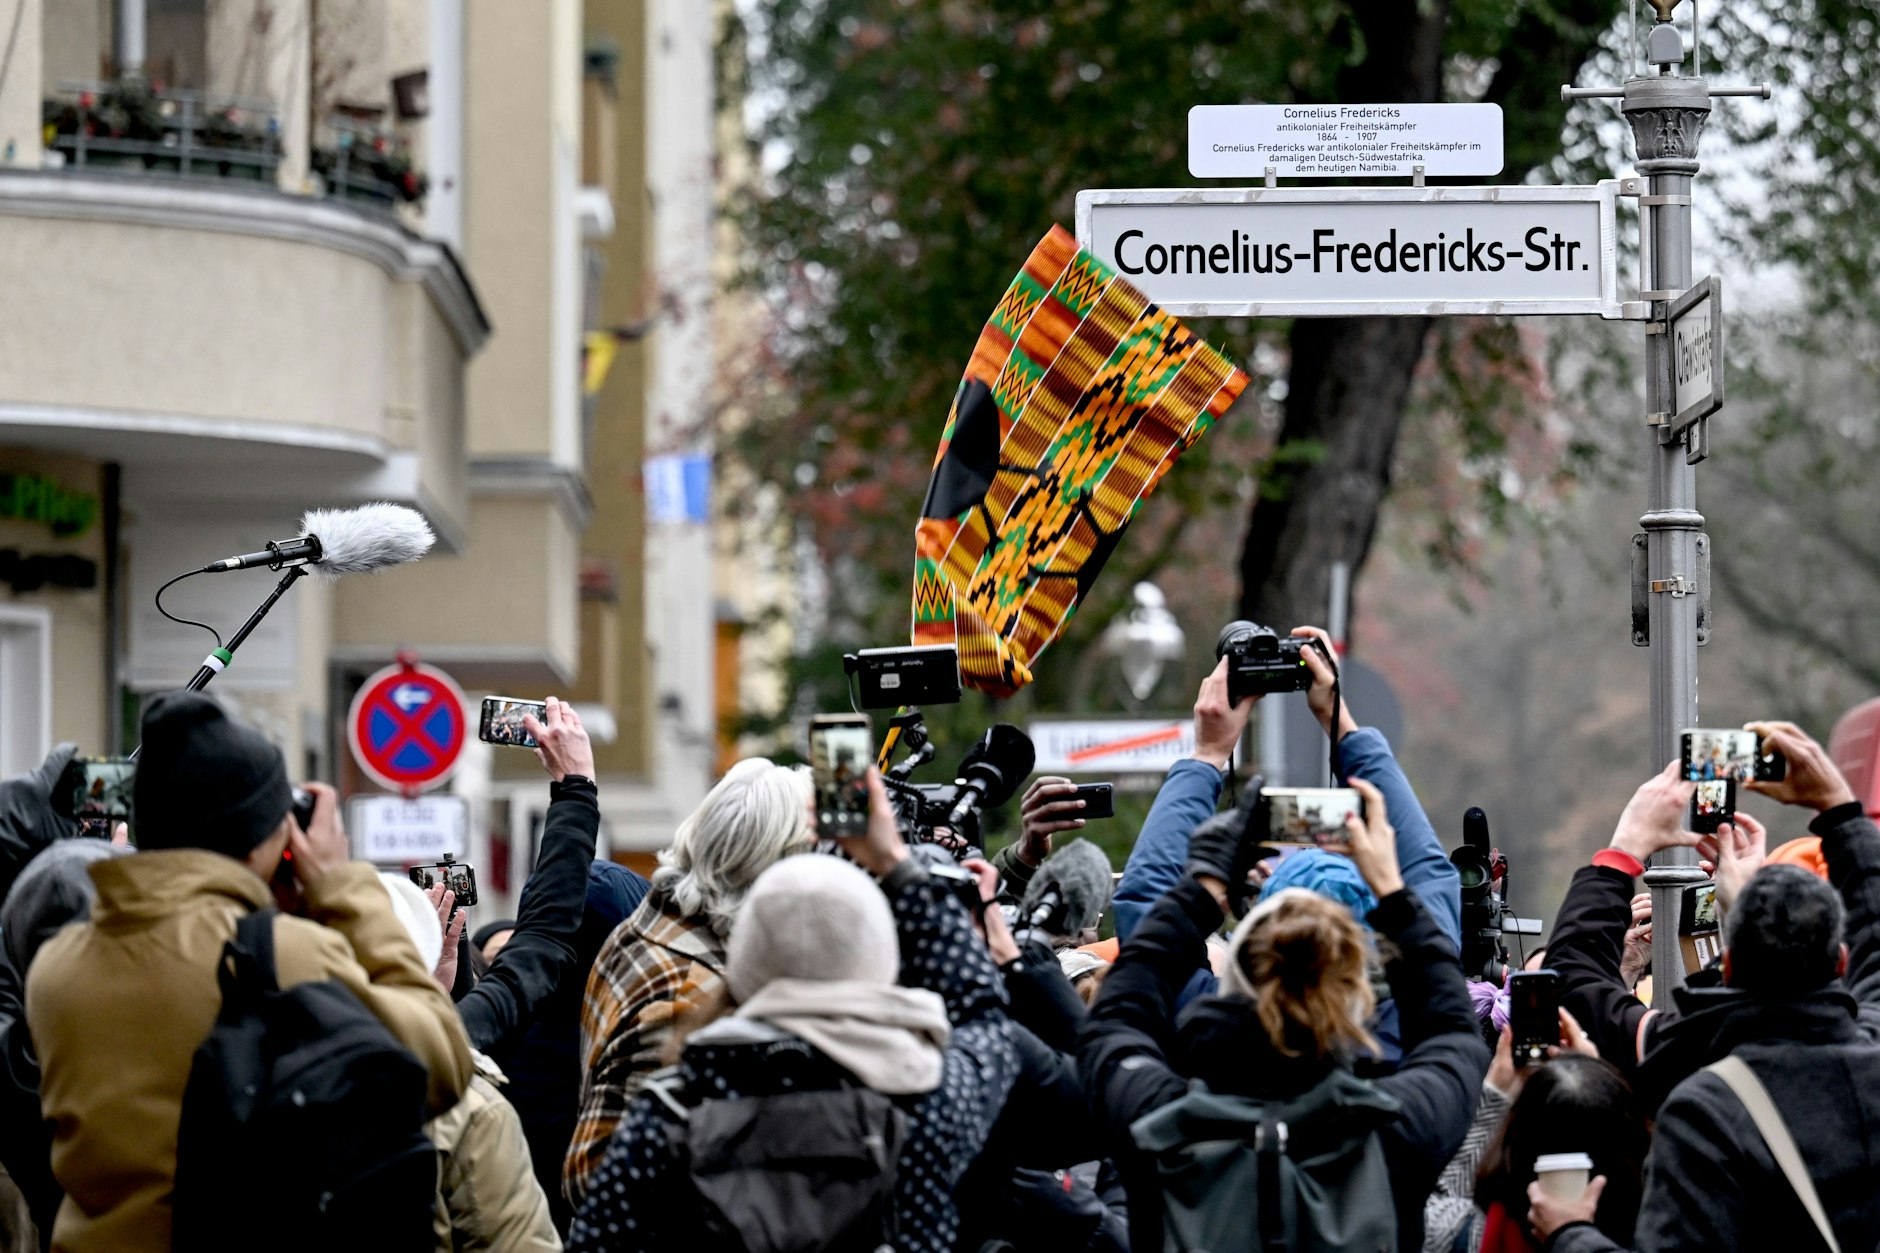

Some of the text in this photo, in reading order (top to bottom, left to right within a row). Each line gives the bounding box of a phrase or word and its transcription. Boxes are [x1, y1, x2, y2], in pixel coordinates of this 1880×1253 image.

[1284, 107, 1401, 119] Cornelius Fredericks
[1276, 121, 1417, 133] antikolonialer Freiheitskämpfer
[1317, 132, 1338, 141] 1864
[1357, 132, 1378, 141] 1907
[1212, 143, 1256, 153] Cornelius
[1257, 143, 1305, 152] Fredericks
[1326, 142, 1389, 152] antikolonialer
[1390, 141, 1468, 153] Freiheitskämpfer
[1469, 142, 1481, 151] im
[1269, 153, 1316, 164] damaligen
[1295, 163, 1316, 173] dem
[1317, 163, 1357, 174] heutigen
[1114, 227, 1590, 275] Cornelius-Fredericks-Str.
